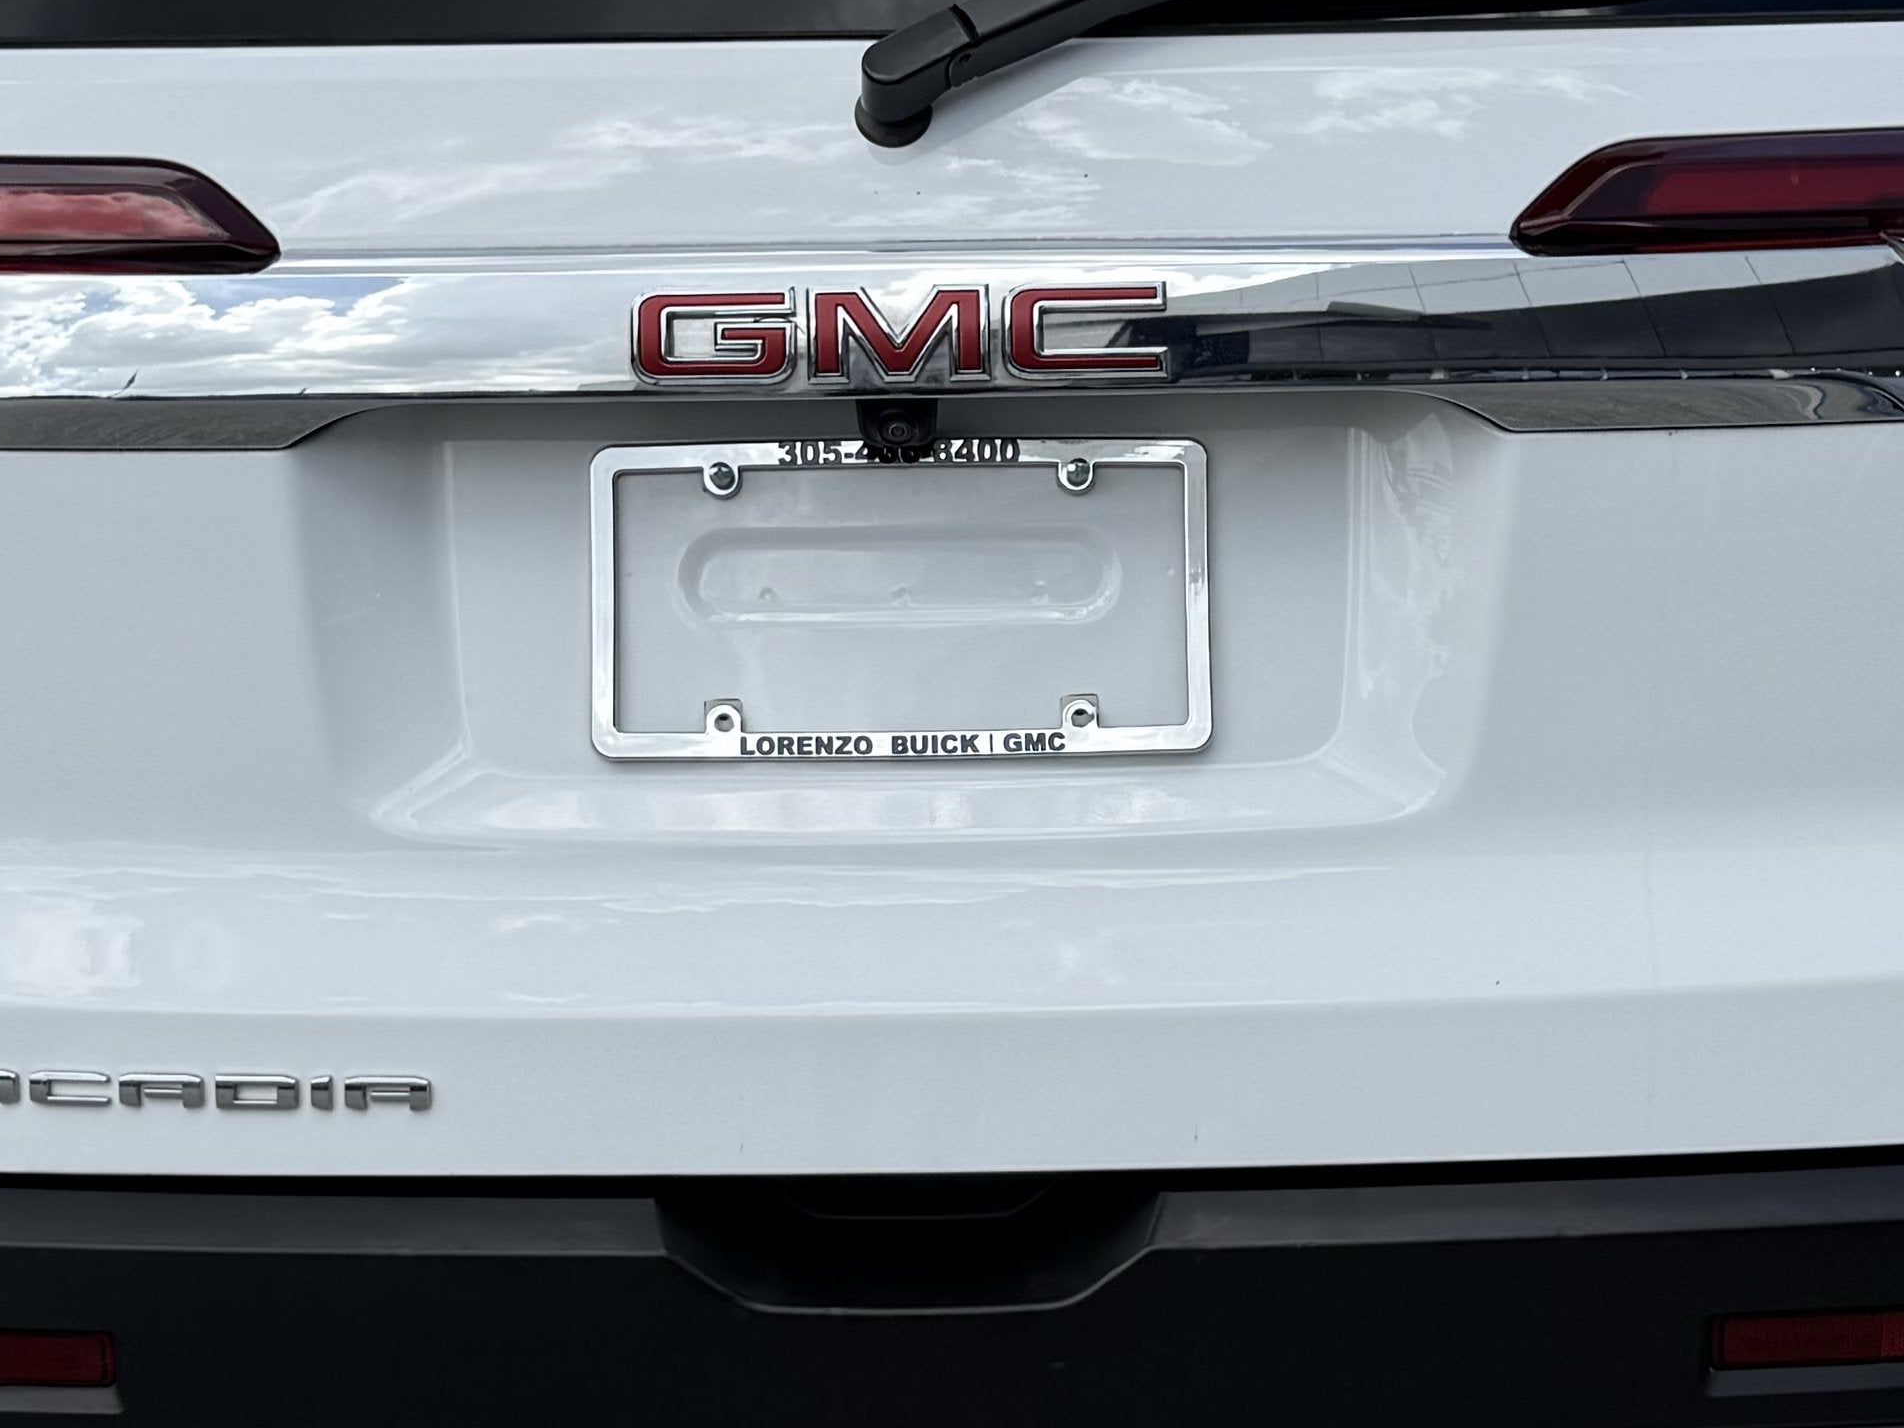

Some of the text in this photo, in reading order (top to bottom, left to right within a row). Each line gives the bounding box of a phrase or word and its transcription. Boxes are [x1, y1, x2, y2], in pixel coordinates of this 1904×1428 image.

[631, 281, 1168, 385] GMC
[740, 732, 1066, 756] LORENZO BUICK GMC
